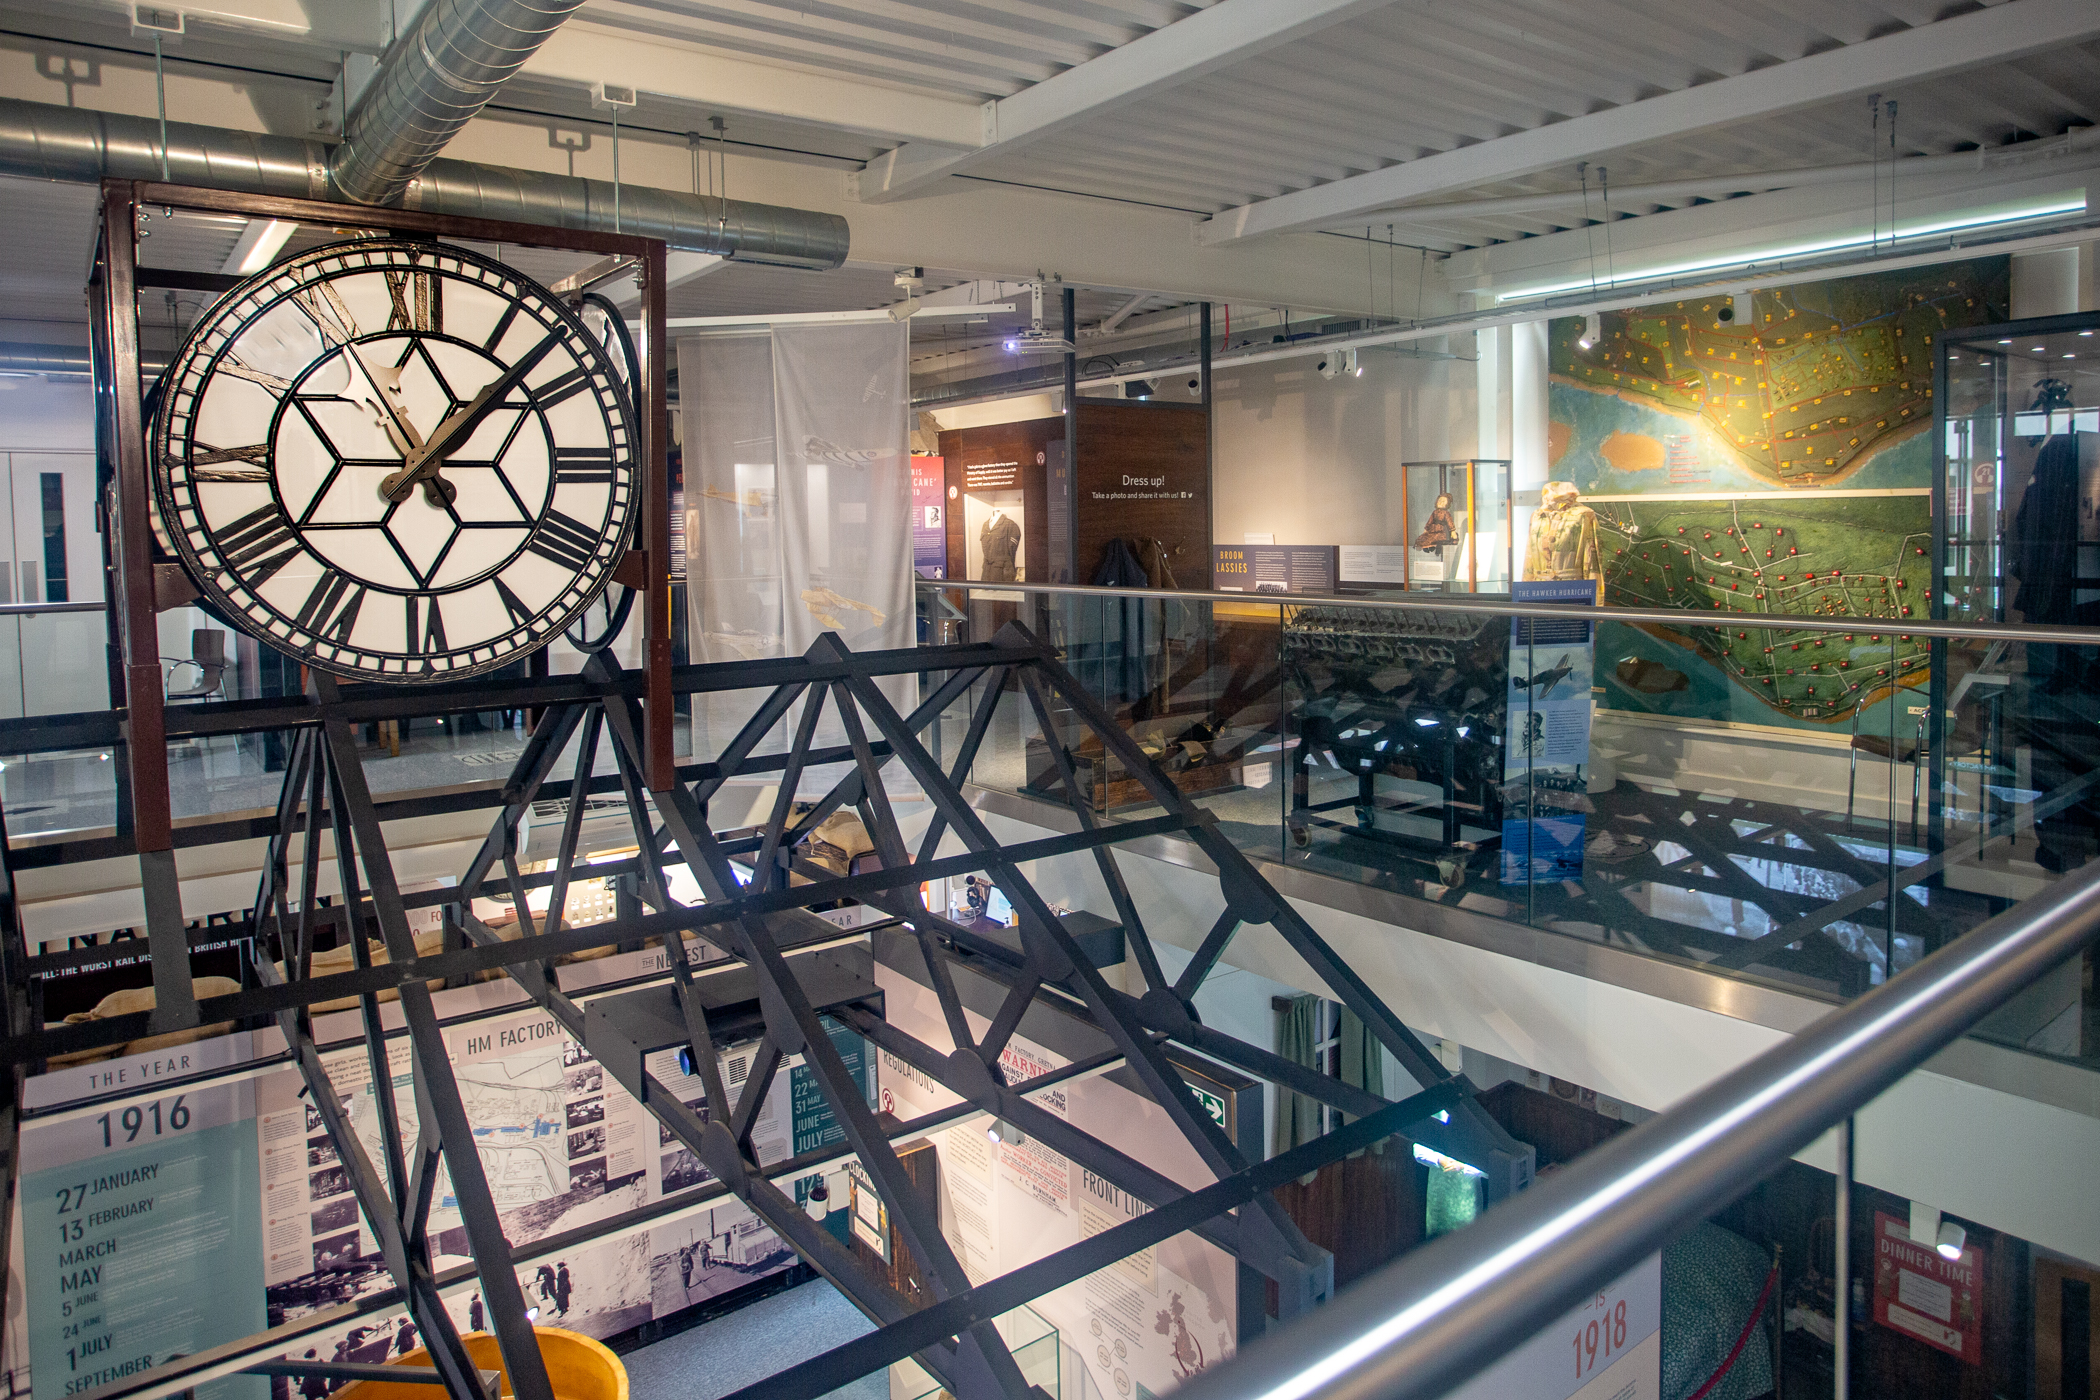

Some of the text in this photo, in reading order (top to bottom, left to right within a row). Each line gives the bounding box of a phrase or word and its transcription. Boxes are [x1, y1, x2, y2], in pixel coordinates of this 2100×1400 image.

[1122, 475, 1165, 488] Dress up!
[1110, 492, 1127, 500] photo
[1216, 563, 1248, 573] LASSIES
[1220, 551, 1243, 560] BROOM
[1532, 589, 1556, 597] HAWKER
[1559, 588, 1592, 597] HURRICANE
[642, 945, 707, 970] THE NEEST
[467, 1020, 561, 1055] HM FACTORY
[90, 1055, 190, 1089] THE YEAR
[1002, 1063, 1024, 1080] GAINST
[795, 1082, 808, 1097] 22
[1053, 1090, 1066, 1102] AND
[795, 1094, 820, 1114] 31 MAY
[97, 1095, 190, 1148] 1916
[796, 1114, 820, 1133] JUNE
[797, 1130, 824, 1153] JULY
[56, 1184, 88, 1214] 27
[91, 1163, 159, 1195] JANUARY
[1083, 1169, 1119, 1207] FRONT
[59, 1198, 154, 1243] 13 FEBRUARY
[59, 1239, 117, 1268] MARCH
[1881, 1239, 1973, 1287] DINNER TIME
[61, 1265, 102, 1293] MAY
[62, 1292, 98, 1317] 5 JUNE
[63, 1315, 101, 1339] 24 JUNE
[1573, 1299, 1627, 1379] 1918
[66, 1334, 112, 1370] 1 JULY
[65, 1355, 152, 1396] SEPTEMBER
